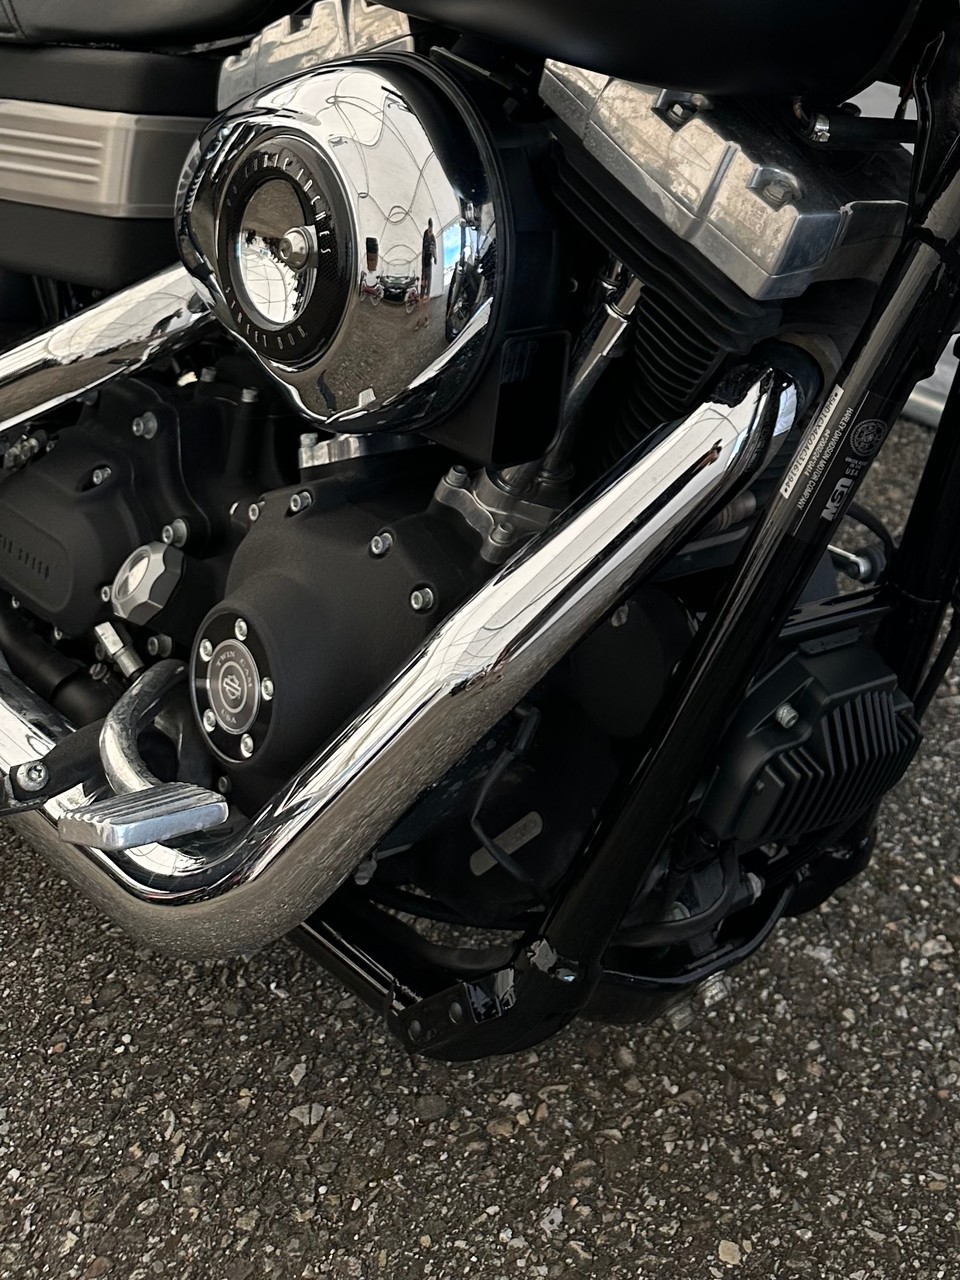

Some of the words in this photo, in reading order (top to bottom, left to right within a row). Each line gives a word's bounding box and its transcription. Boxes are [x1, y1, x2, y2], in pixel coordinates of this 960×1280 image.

[823, 407, 853, 460] HARLEY-DAVIDSON
[811, 458, 827, 481] MOTOR
[796, 480, 816, 510] COMPANY
[216, 650, 236, 666] TWIN
[240, 658, 253, 688] CAM
[221, 709, 237, 723] USA
